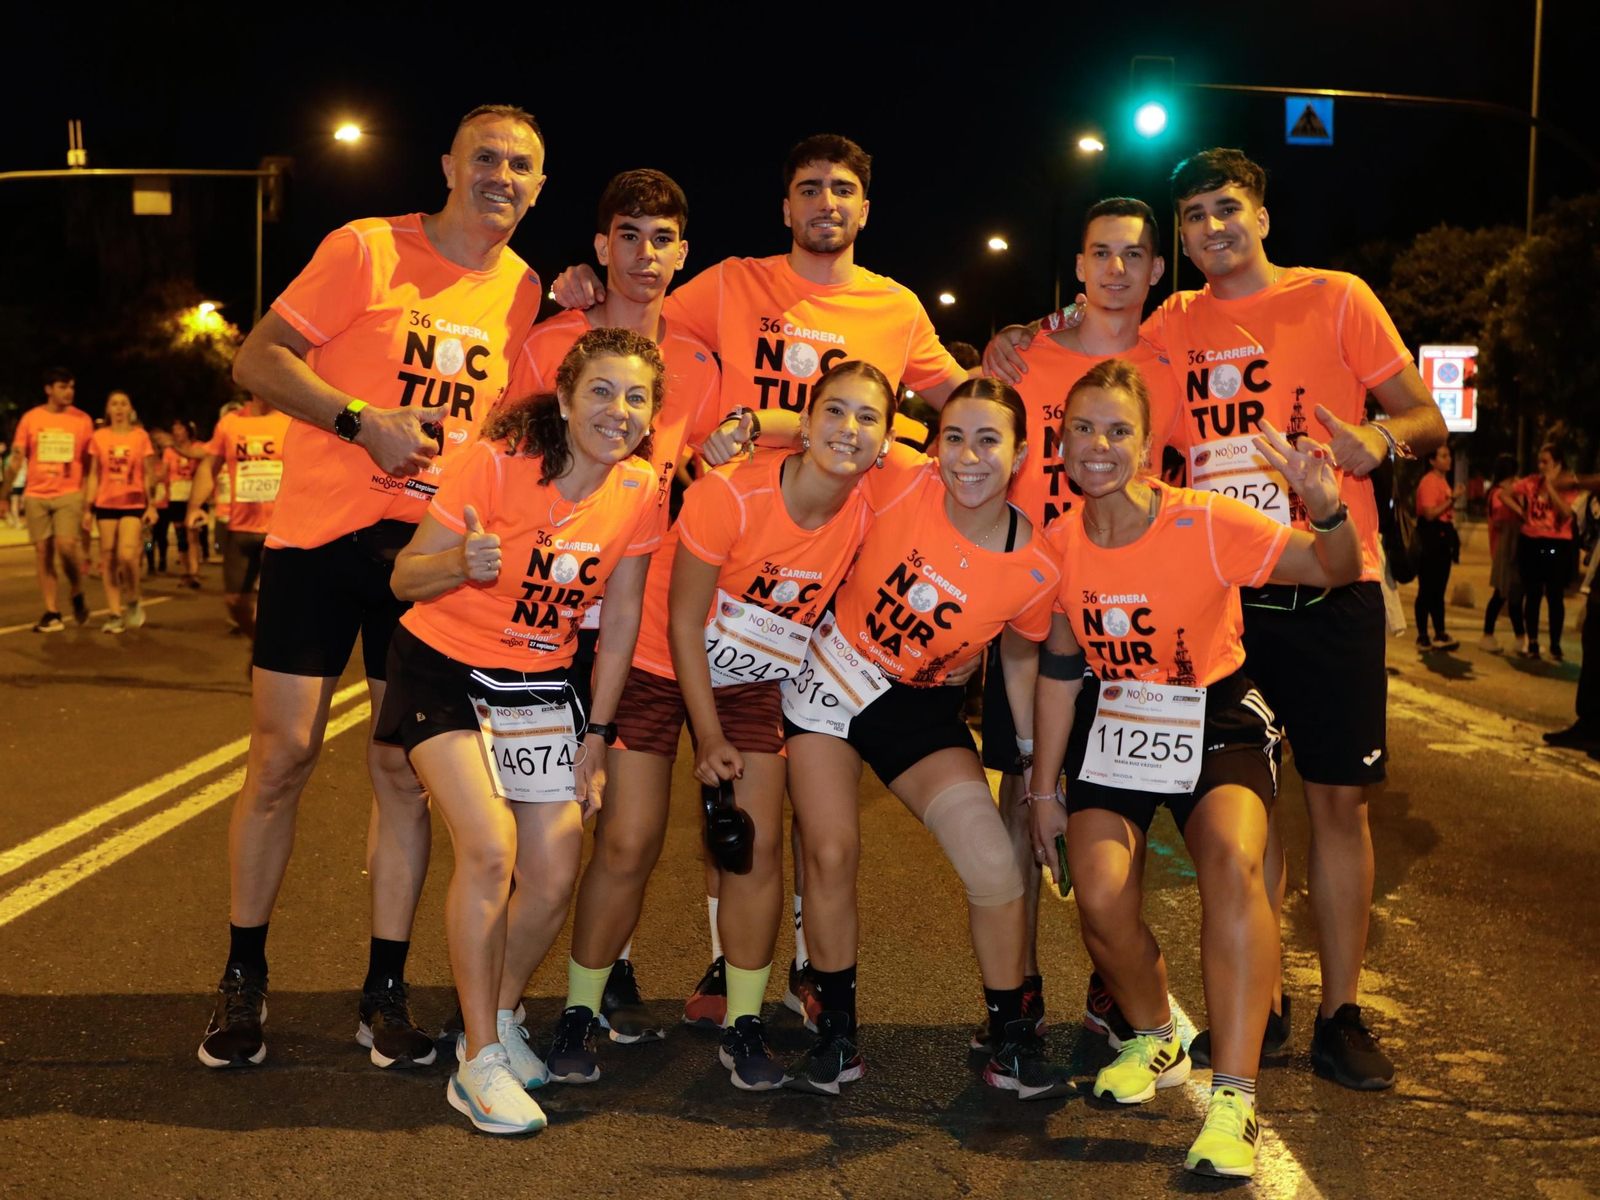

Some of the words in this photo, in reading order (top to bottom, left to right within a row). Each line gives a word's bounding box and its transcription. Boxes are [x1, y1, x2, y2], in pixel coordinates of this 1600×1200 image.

[409, 310, 432, 329] 36
[434, 318, 490, 342] CARRERA
[760, 317, 780, 333] 36
[784, 324, 846, 344] CARRERA
[1188, 350, 1205, 365] 36
[1206, 345, 1265, 362] CARRERA
[397, 370, 474, 422] TUR
[754, 376, 815, 413] TU
[1042, 404, 1064, 420] 36
[1191, 400, 1264, 439] TUR
[404, 489, 426, 500] SEVILLA
[536, 530, 552, 547] 36
[555, 539, 600, 552] CARRERA
[761, 562, 780, 576] 36
[780, 567, 822, 580] CARRERA
[907, 548, 926, 568] 36
[922, 564, 968, 603] CARRERA
[521, 581, 584, 609] TUR
[1082, 590, 1098, 604] 36
[1099, 594, 1148, 604] CARRERA
[511, 600, 558, 629] NA
[874, 587, 934, 648] TUR
[866, 612, 902, 658] NA
[1088, 641, 1158, 666] TUR
[826, 720, 845, 728] POWER
[1098, 724, 1194, 763] 11255
[490, 744, 574, 776] 14674
[1114, 758, 1128, 766] MARÍA
